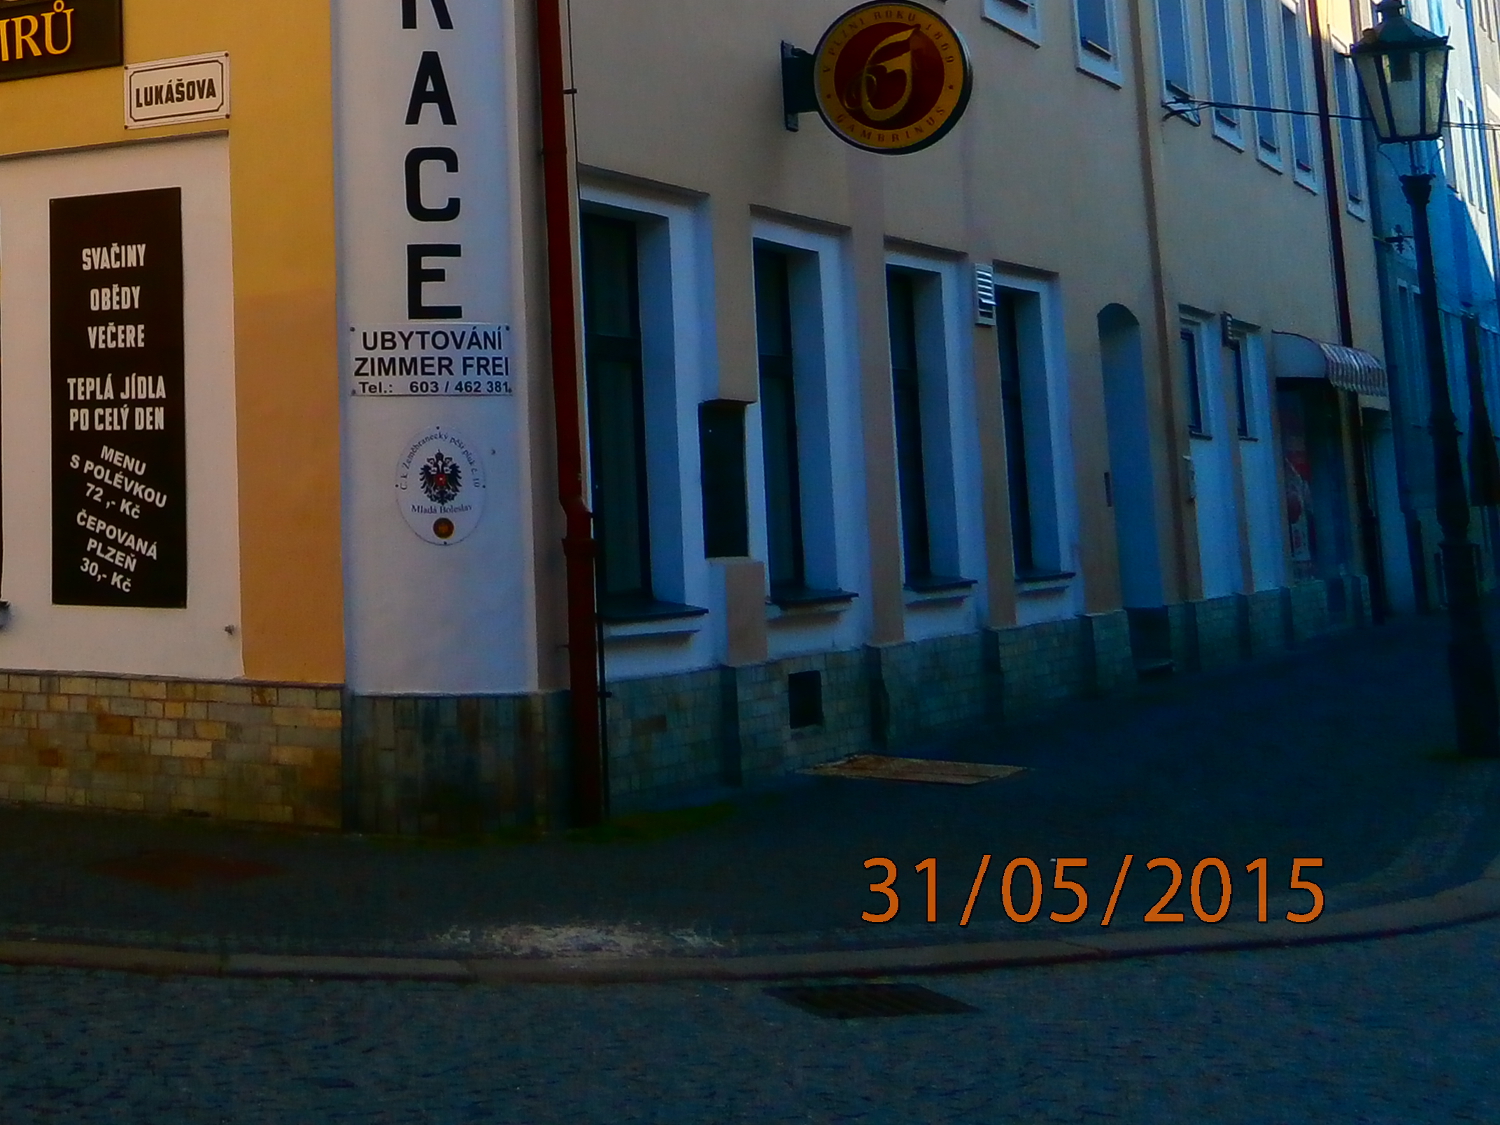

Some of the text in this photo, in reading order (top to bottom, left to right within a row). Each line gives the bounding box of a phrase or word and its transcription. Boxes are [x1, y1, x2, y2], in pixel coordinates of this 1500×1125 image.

[873, 10, 917, 22] ROKU
[136, 78, 216, 107] LUKÁŠOVA
[836, 107, 946, 143] GAMBRINUS
[82, 243, 146, 270] SVAČINY
[90, 284, 140, 311] OBĚDY
[87, 322, 145, 349] VEČERE
[362, 326, 502, 351] UBYTOVÁNÍ
[354, 357, 509, 376] ZIMMER FREI
[67, 373, 166, 400] TEPLÁ JÍDLA
[359, 381, 509, 394] Tel.: 603 / 462 381
[70, 404, 164, 431] PO CELÝ DEN
[100, 445, 146, 475] MENU
[70, 454, 167, 508] S POLÉVKOU
[85, 482, 104, 502] 72
[120, 498, 141, 519] Kč
[411, 504, 437, 514] Mladá
[76, 508, 158, 560] ČEPOVANÁ
[87, 538, 137, 572] PLZEŇ
[80, 557, 132, 592] 30,- Kč
